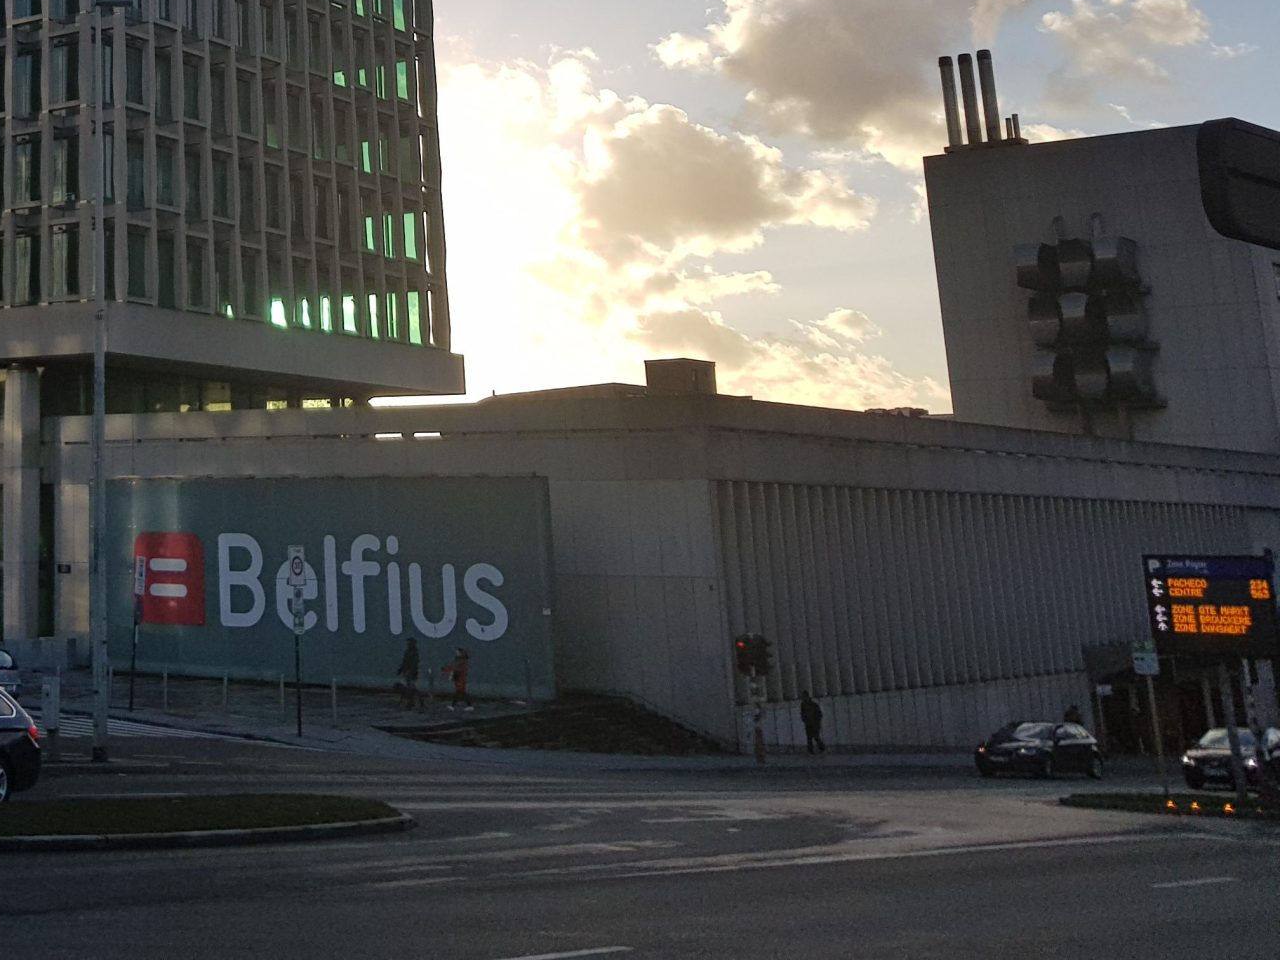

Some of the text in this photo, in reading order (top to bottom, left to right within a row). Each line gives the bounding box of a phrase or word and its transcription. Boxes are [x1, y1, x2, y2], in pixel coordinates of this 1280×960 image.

[1148, 559, 1160, 572] P
[218, 533, 509, 640] Belfius
[1167, 578, 1208, 588] PACHECO
[1168, 588, 1204, 597] CENTRE
[1171, 604, 1194, 614] ZONE
[1220, 606, 1249, 615] MARKT
[1173, 614, 1252, 625] ZONE BROUCKERE
[1174, 623, 1198, 632] ZONE
